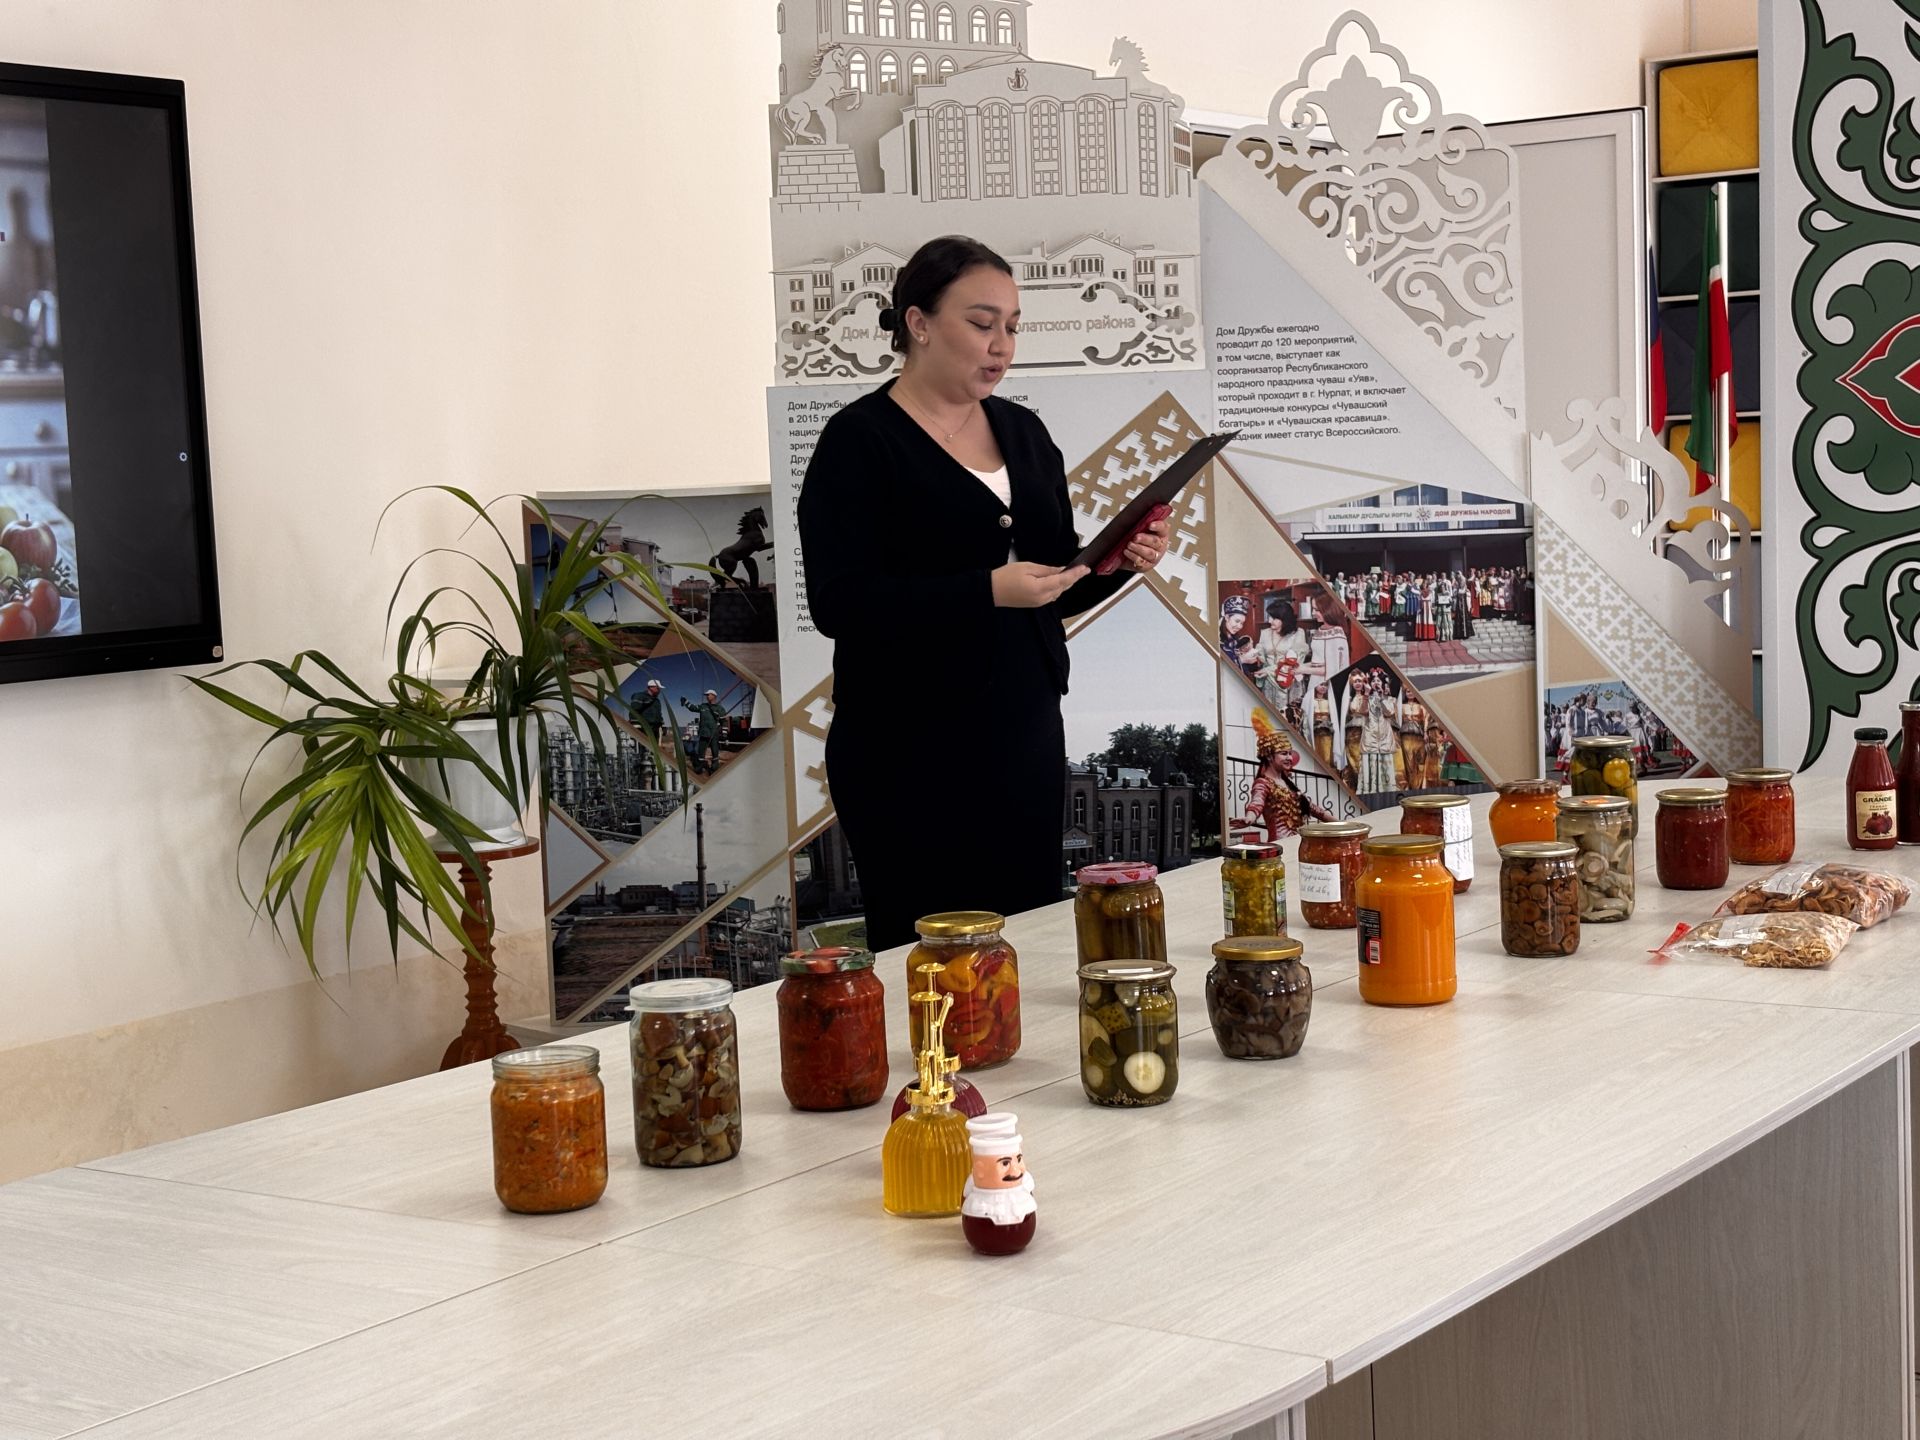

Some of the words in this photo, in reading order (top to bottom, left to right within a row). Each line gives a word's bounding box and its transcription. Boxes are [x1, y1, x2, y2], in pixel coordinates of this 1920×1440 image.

[841, 326, 870, 341] Дом
[1086, 315, 1136, 332] района
[1216, 327, 1236, 337] Дом
[1238, 325, 1274, 336] Дружбы
[1276, 325, 1320, 333] ежегодно
[1216, 341, 1259, 350] проводит
[1261, 340, 1273, 348] до
[1276, 338, 1292, 346] 120
[1294, 335, 1357, 346] мероприятий,
[1244, 353, 1273, 361] числе,
[1276, 350, 1323, 360] выступает
[1326, 350, 1341, 358] как
[1217, 366, 1283, 376] соорганизатор
[1286, 361, 1368, 374] Республиканского
[1218, 380, 1265, 390] народного
[1267, 378, 1314, 388] праздника
[1317, 376, 1345, 386] чуваш
[1218, 393, 1255, 403] который
[1258, 391, 1300, 402] проходит
[1318, 388, 1352, 399] Нурлат,
[1363, 387, 1406, 396] включает
[788, 402, 807, 411] Дом
[1219, 405, 1285, 416] традиционные
[1287, 403, 1330, 414] конкурсы
[1332, 400, 1388, 411] «Чувашский
[797, 414, 819, 423] 2015
[1219, 419, 1266, 428] богатырь»
[1277, 416, 1332, 427] «Чувашская
[1265, 431, 1292, 439] имеет
[1294, 429, 1324, 440] статус
[1326, 426, 1401, 438] Всероссийского.
[1451, 508, 1479, 517] ДРУЖБЫ
